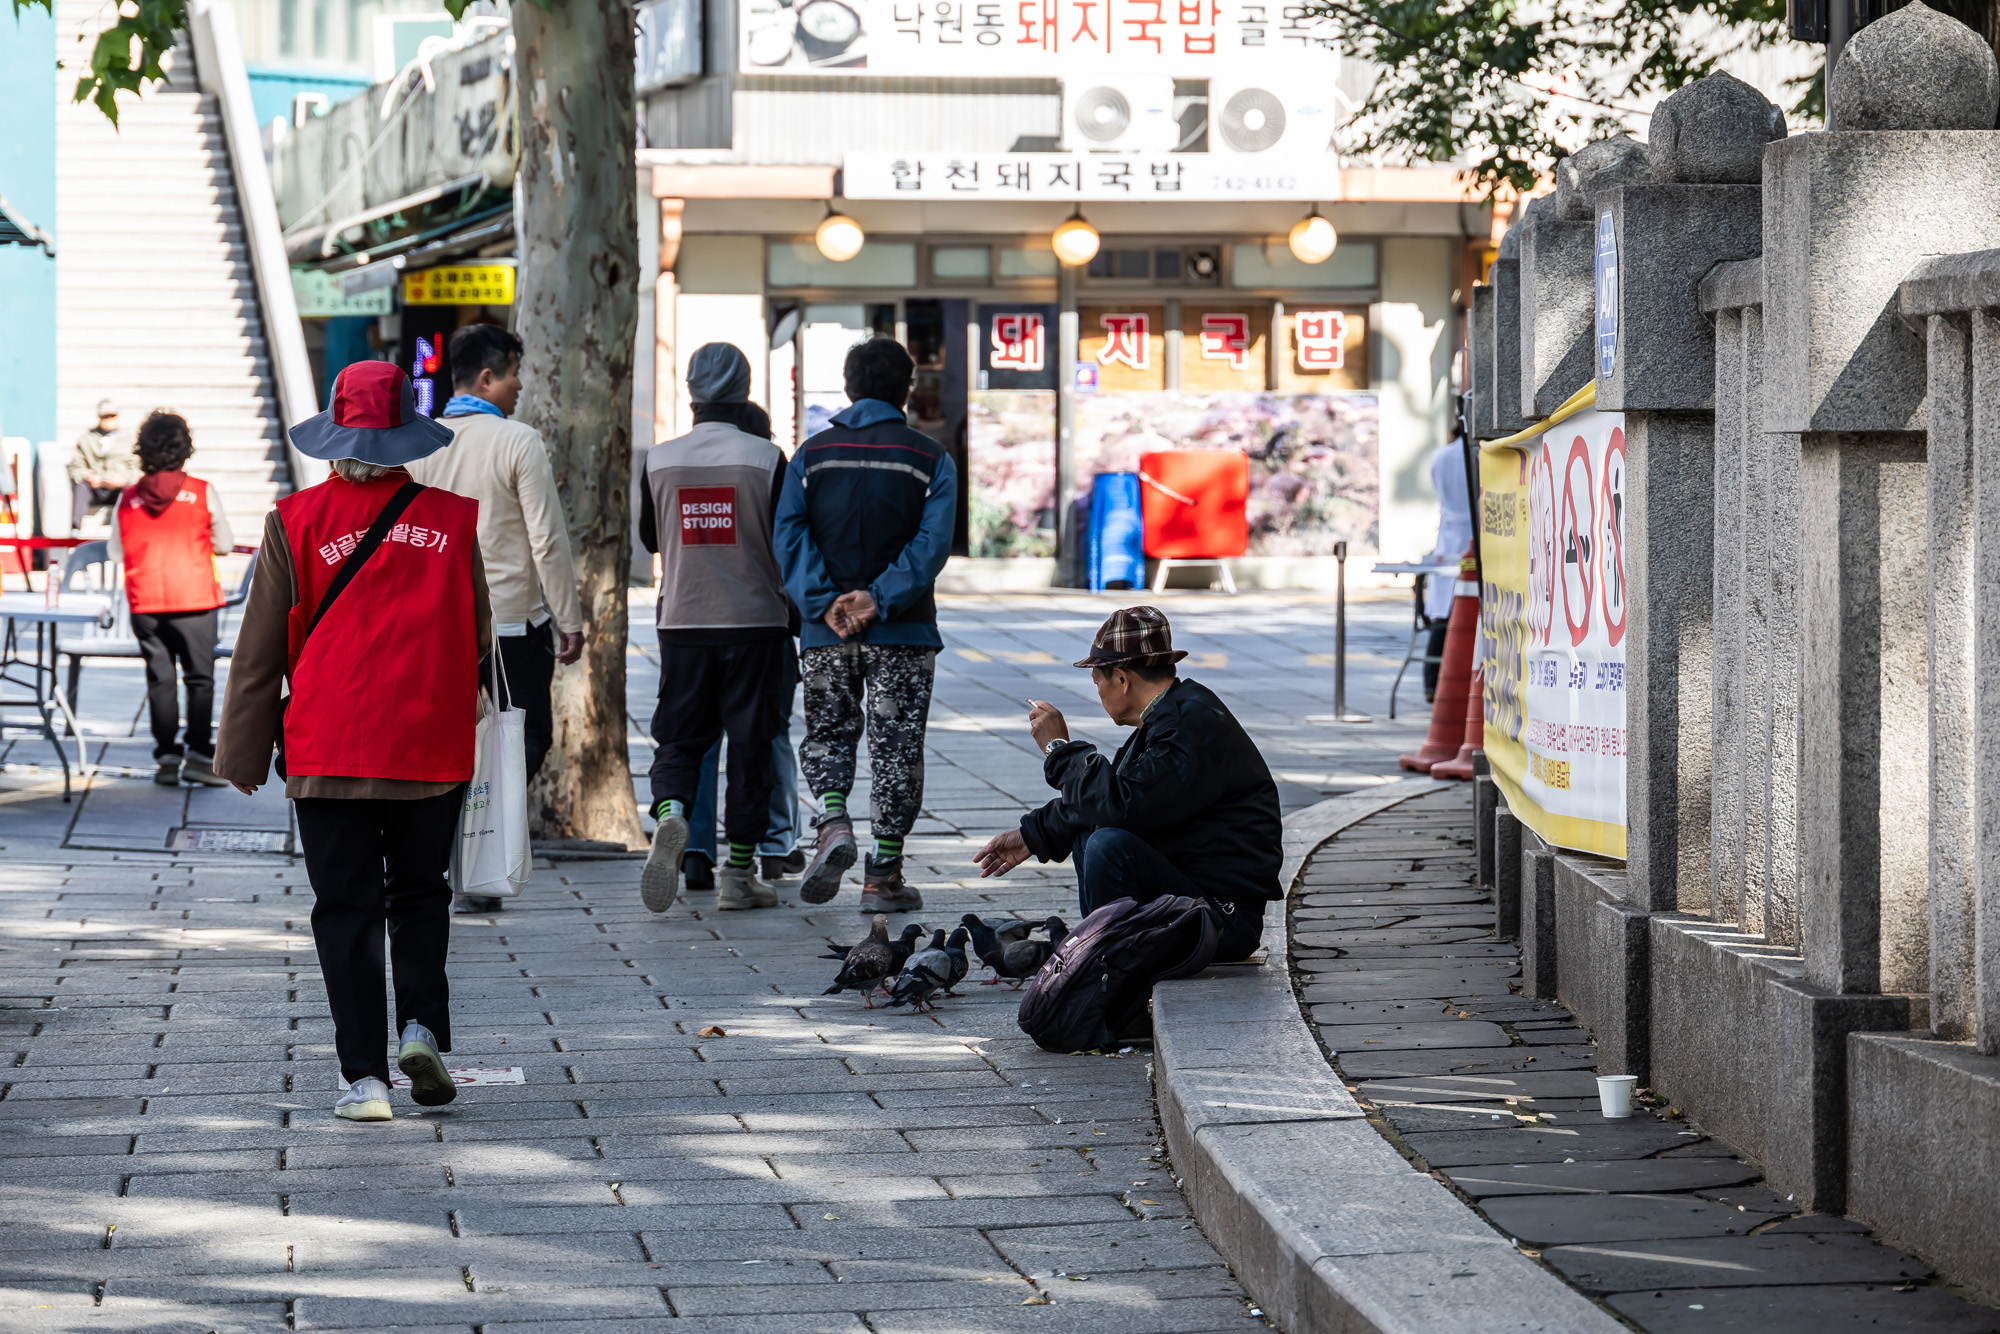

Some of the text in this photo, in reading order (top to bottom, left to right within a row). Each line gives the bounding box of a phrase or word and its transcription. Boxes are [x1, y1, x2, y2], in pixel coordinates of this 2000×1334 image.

[893, 1, 1005, 46] 낙원동
[1016, 0, 1221, 54] 돼지국밥
[682, 503, 732, 515] DESIGN
[683, 517, 732, 529] STUDIO
[318, 523, 448, 566] 탑골활동가
